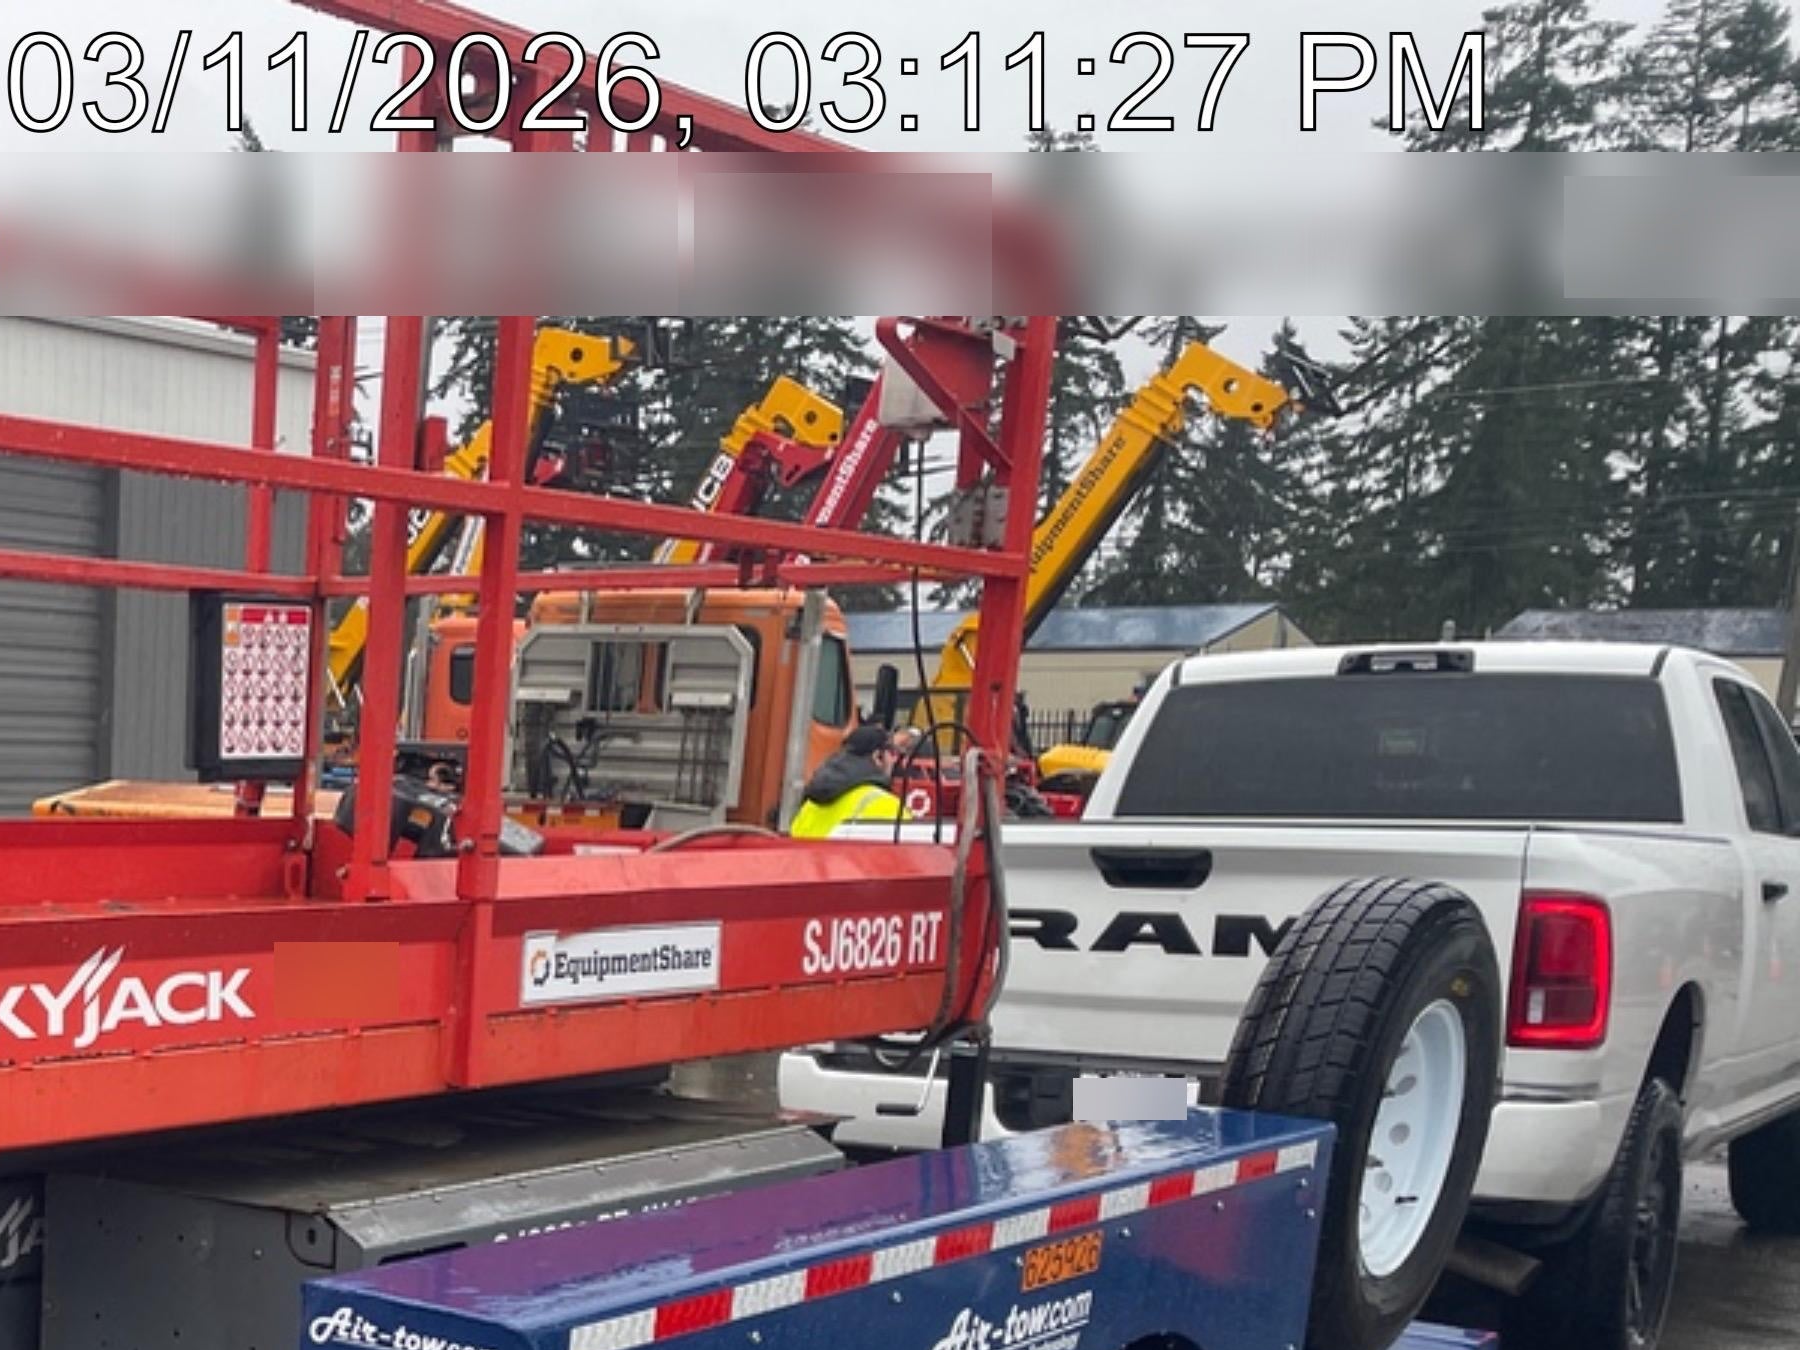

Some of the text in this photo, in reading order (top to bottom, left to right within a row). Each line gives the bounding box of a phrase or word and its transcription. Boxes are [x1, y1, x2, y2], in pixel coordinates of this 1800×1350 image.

[803, 911, 943, 976] SJ6826 RT
[1007, 908, 1300, 957] RAM
[553, 944, 713, 985] EquipmentShare
